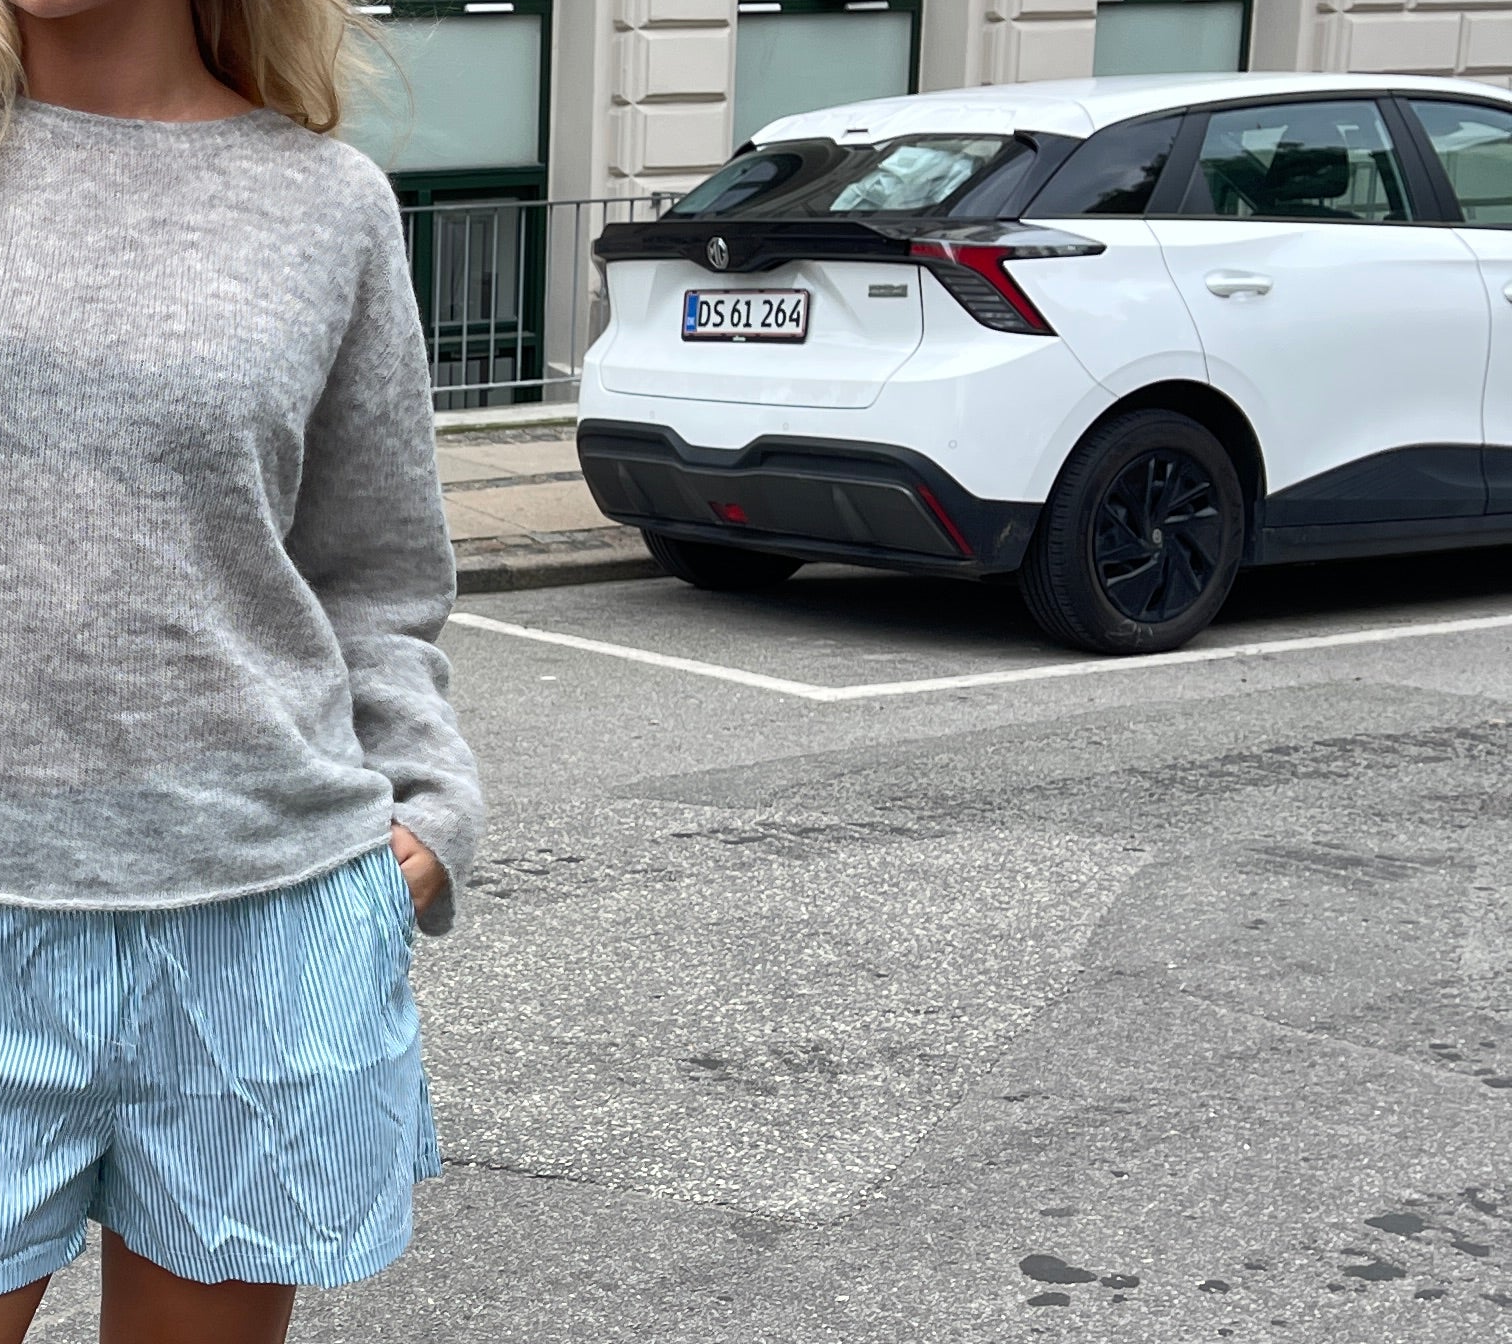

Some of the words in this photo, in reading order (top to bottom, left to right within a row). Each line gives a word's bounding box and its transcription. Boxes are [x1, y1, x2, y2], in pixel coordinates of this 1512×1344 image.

[698, 300, 725, 328] DS
[730, 299, 752, 328] 61
[761, 298, 802, 328] 264
